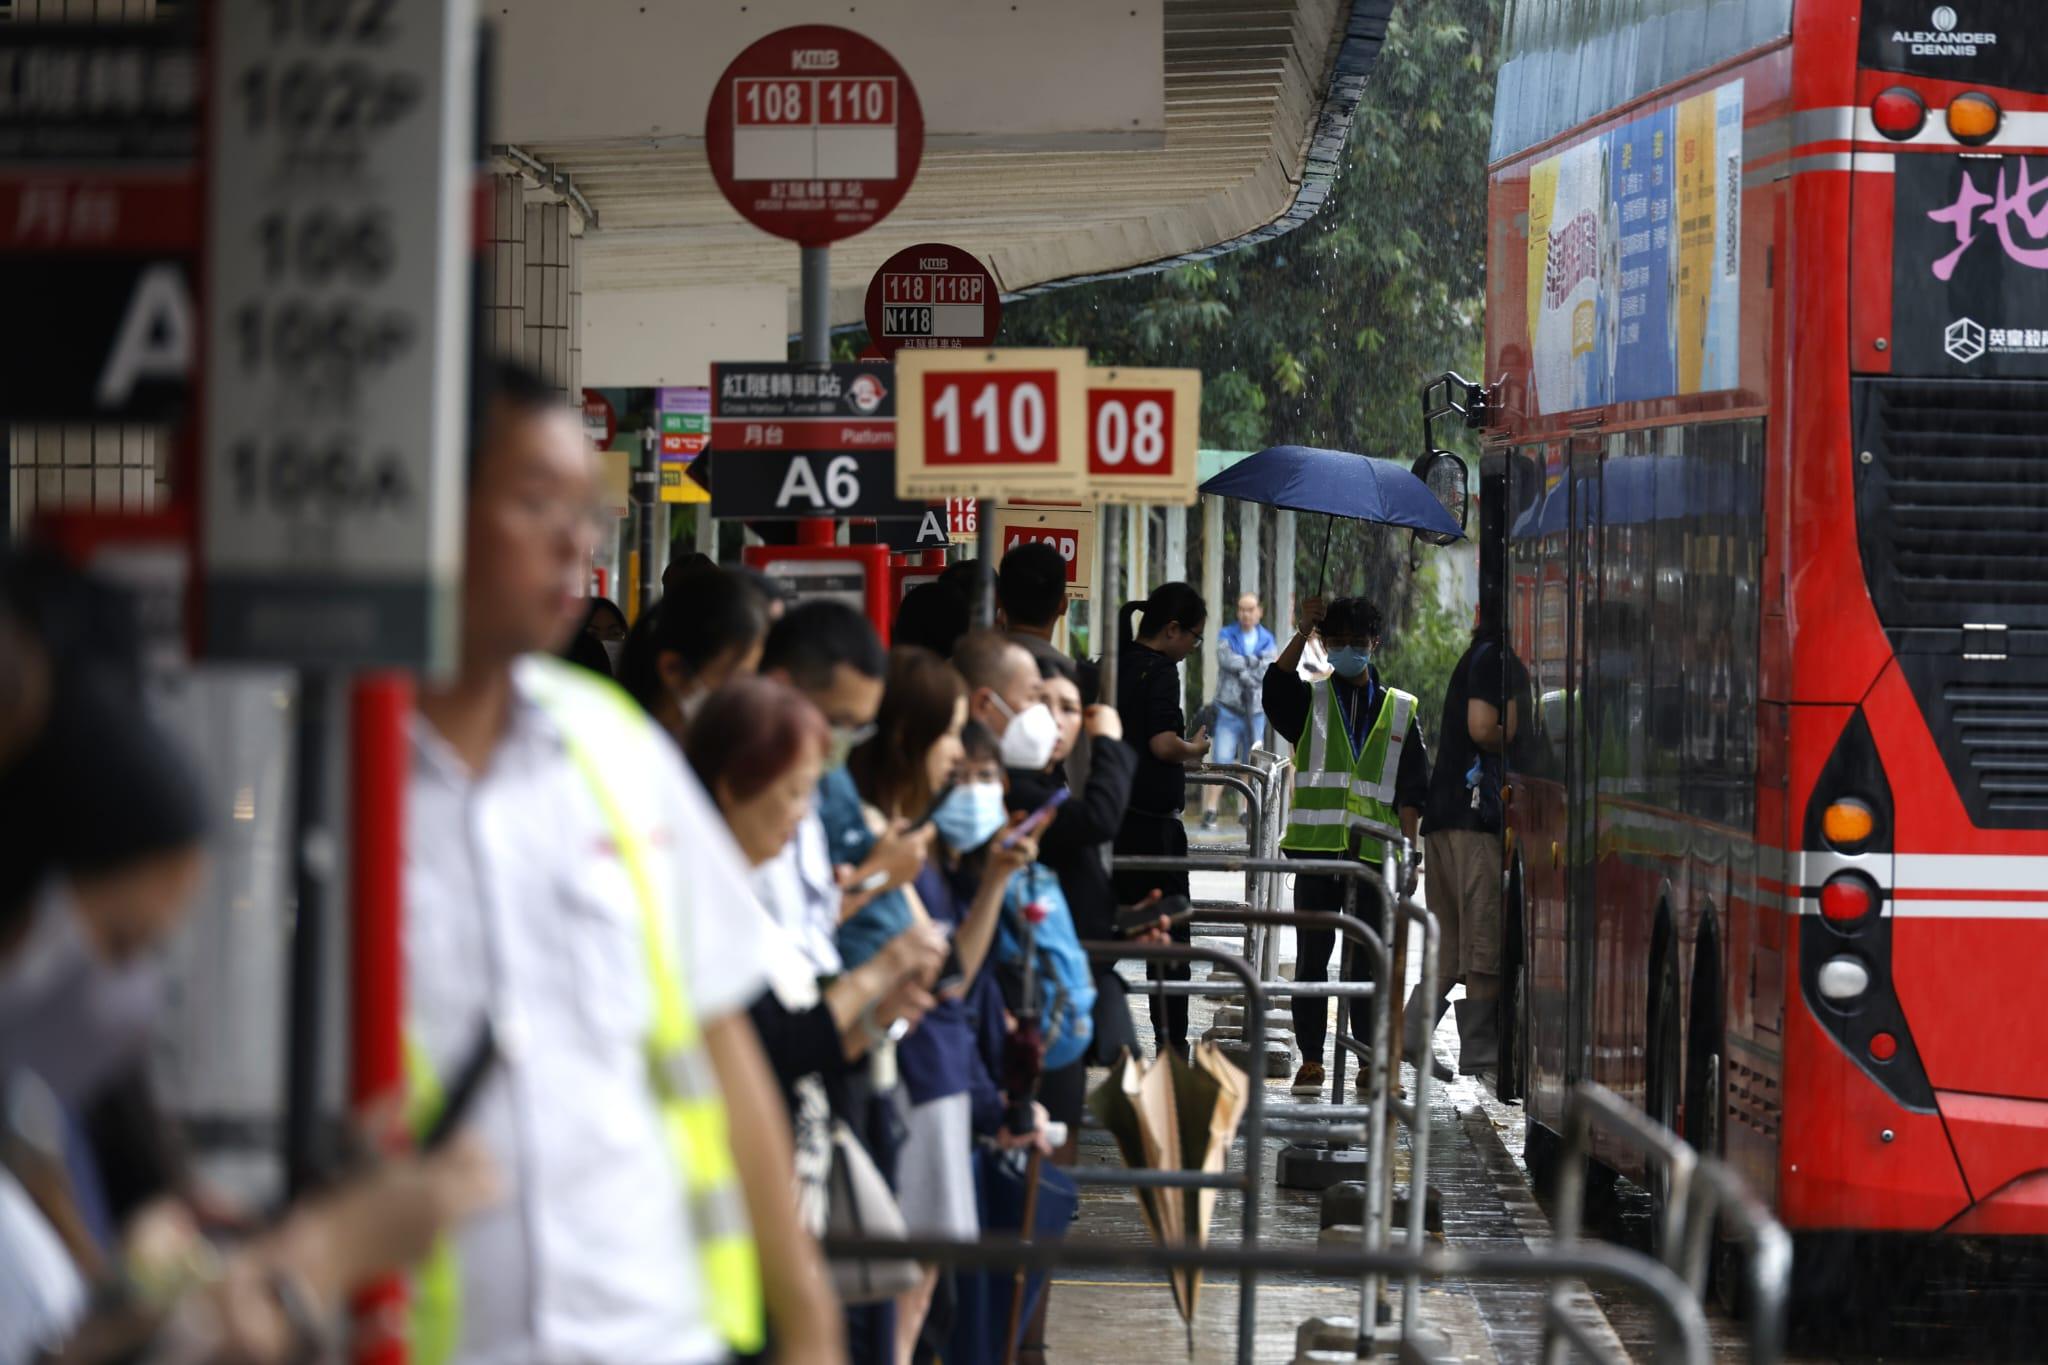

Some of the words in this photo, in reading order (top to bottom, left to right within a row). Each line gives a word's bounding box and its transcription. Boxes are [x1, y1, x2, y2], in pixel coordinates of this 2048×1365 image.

[1891, 31, 1997, 45] ALEXANDER
[1911, 44, 1978, 57] DENNIS
[747, 83, 801, 121] 108
[828, 83, 884, 121] 110
[890, 276, 924, 300] 118
[937, 277, 982, 301] 118P
[885, 308, 931, 332] N118
[932, 382, 1045, 455] 110
[744, 425, 784, 446] 月台
[841, 428, 894, 444] Platform
[1096, 400, 1164, 466] 08
[775, 456, 860, 508] A6
[916, 510, 946, 543] A
[946, 513, 977, 532] 116
